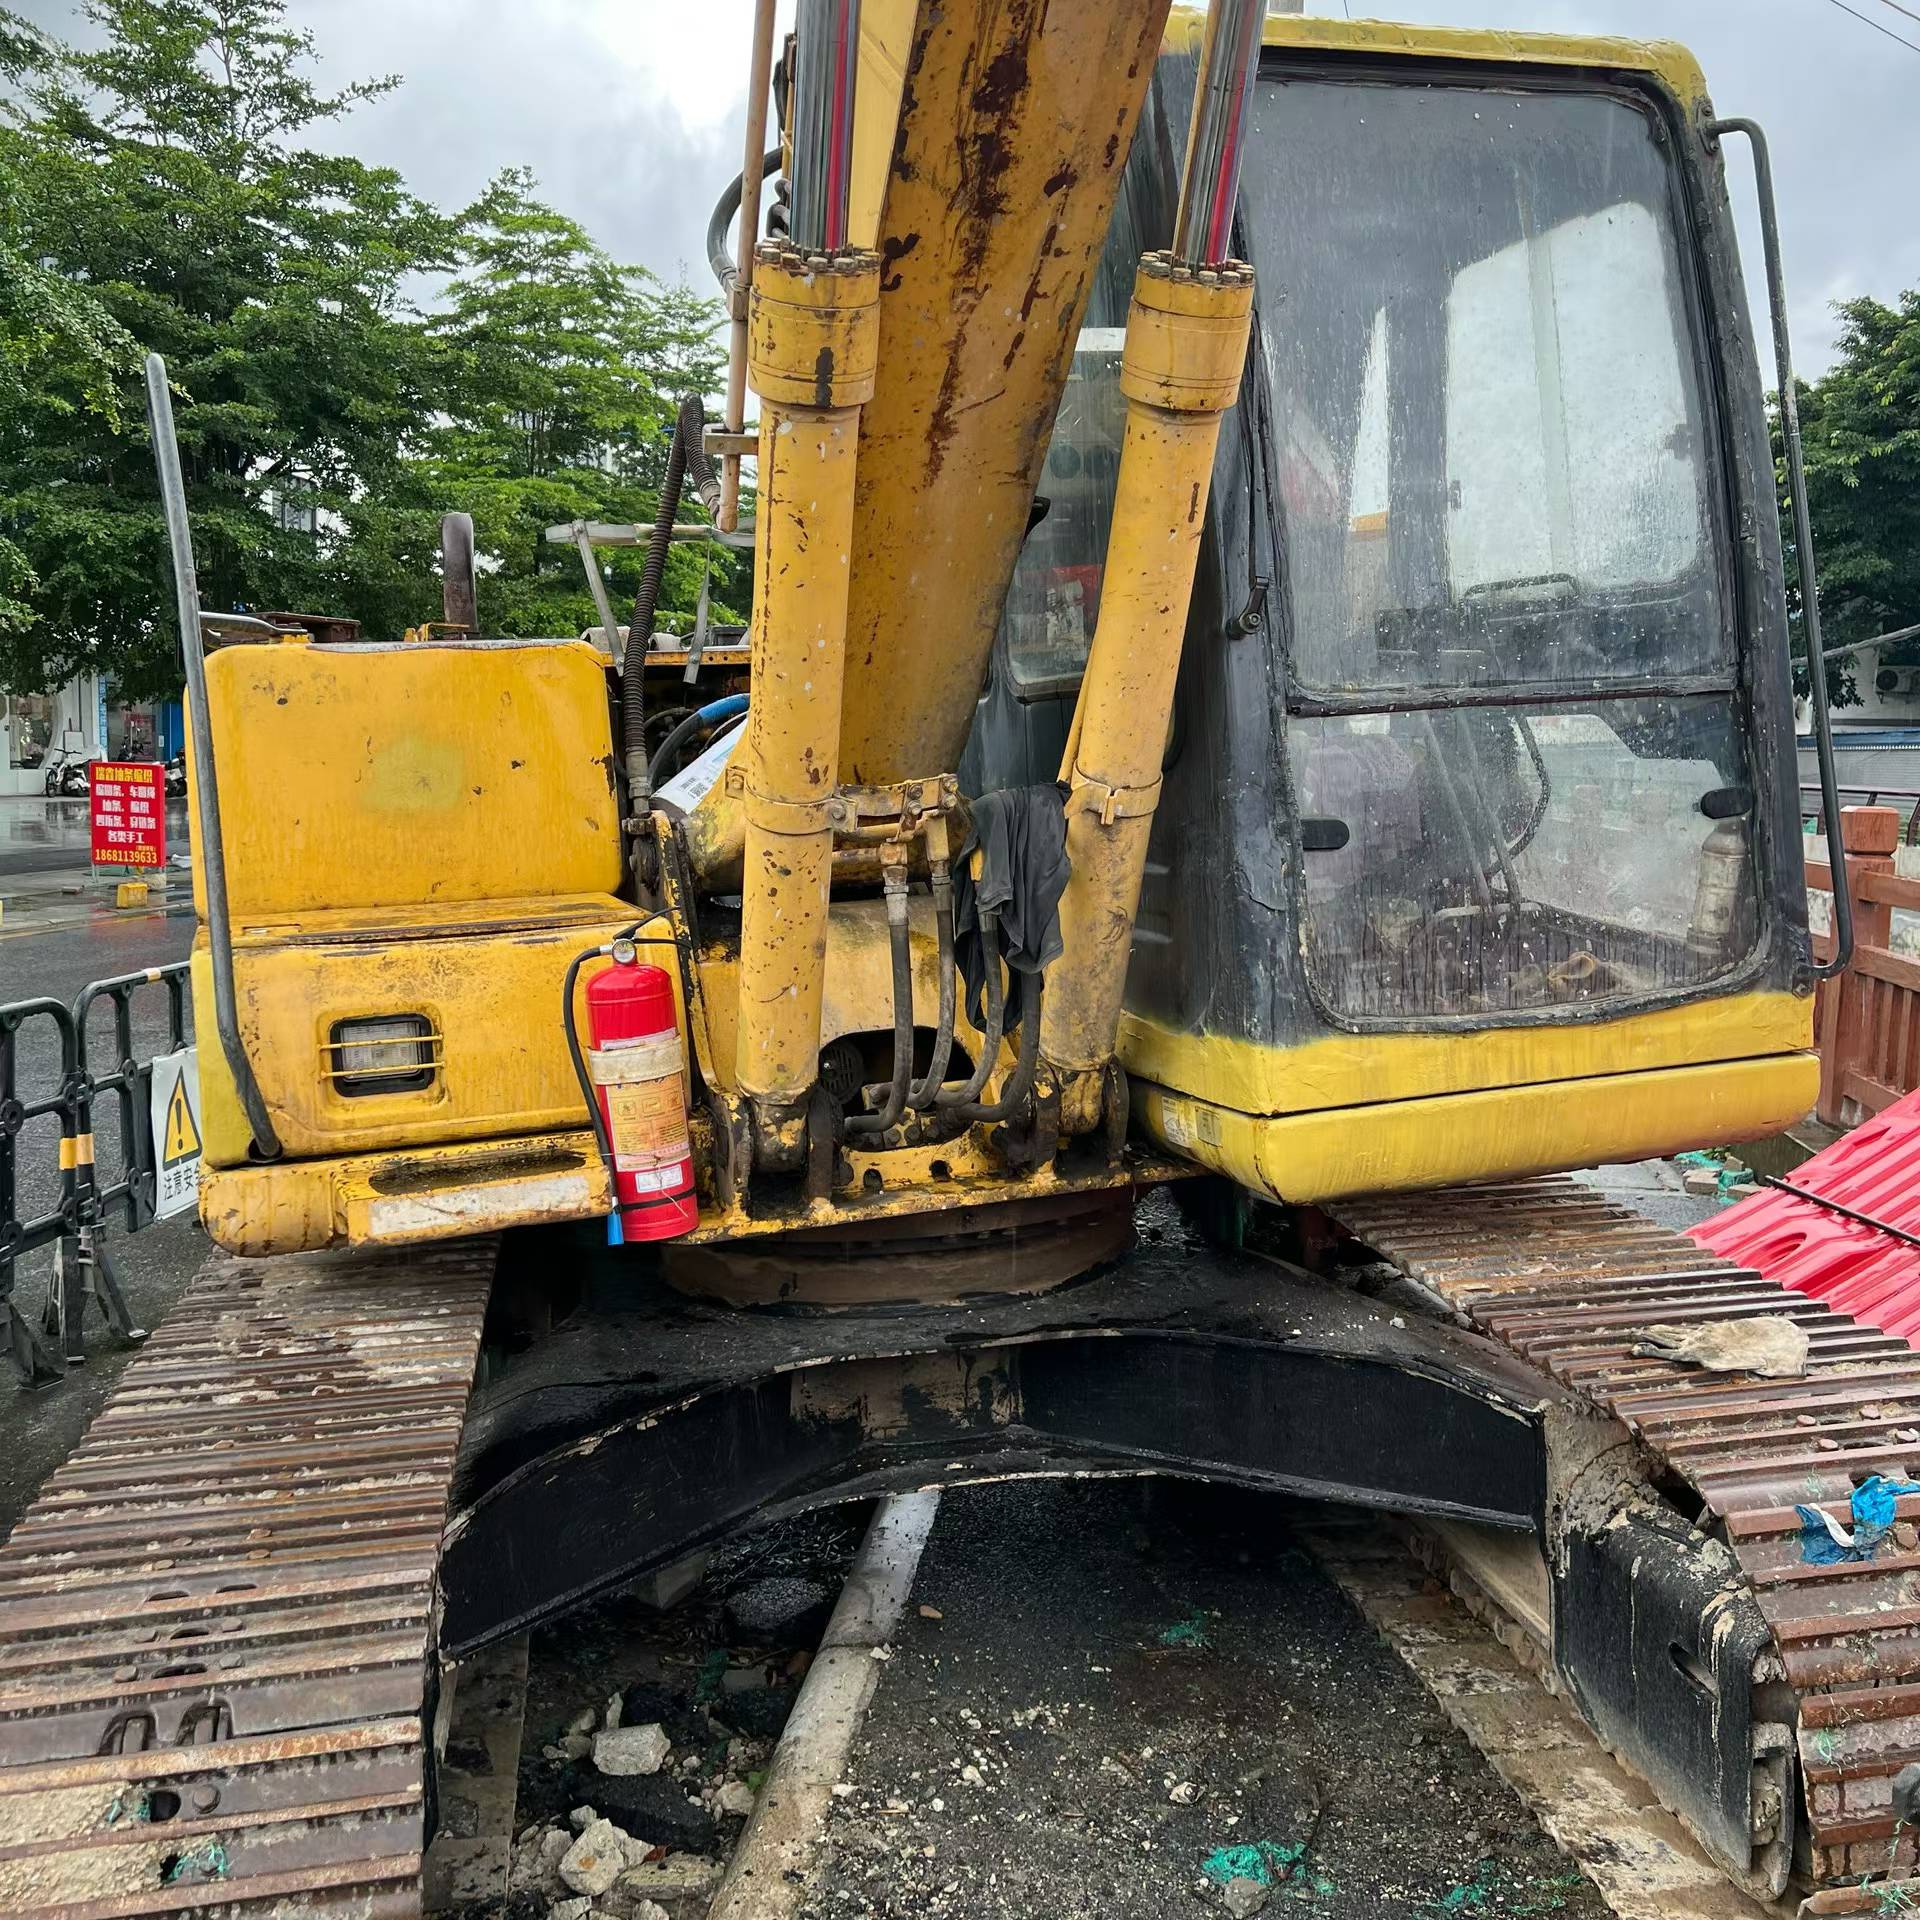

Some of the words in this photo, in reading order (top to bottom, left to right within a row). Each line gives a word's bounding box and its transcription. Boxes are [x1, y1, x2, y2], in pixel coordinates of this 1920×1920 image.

[107, 830, 145, 844] 各类手工
[95, 848, 157, 864] 18681139633
